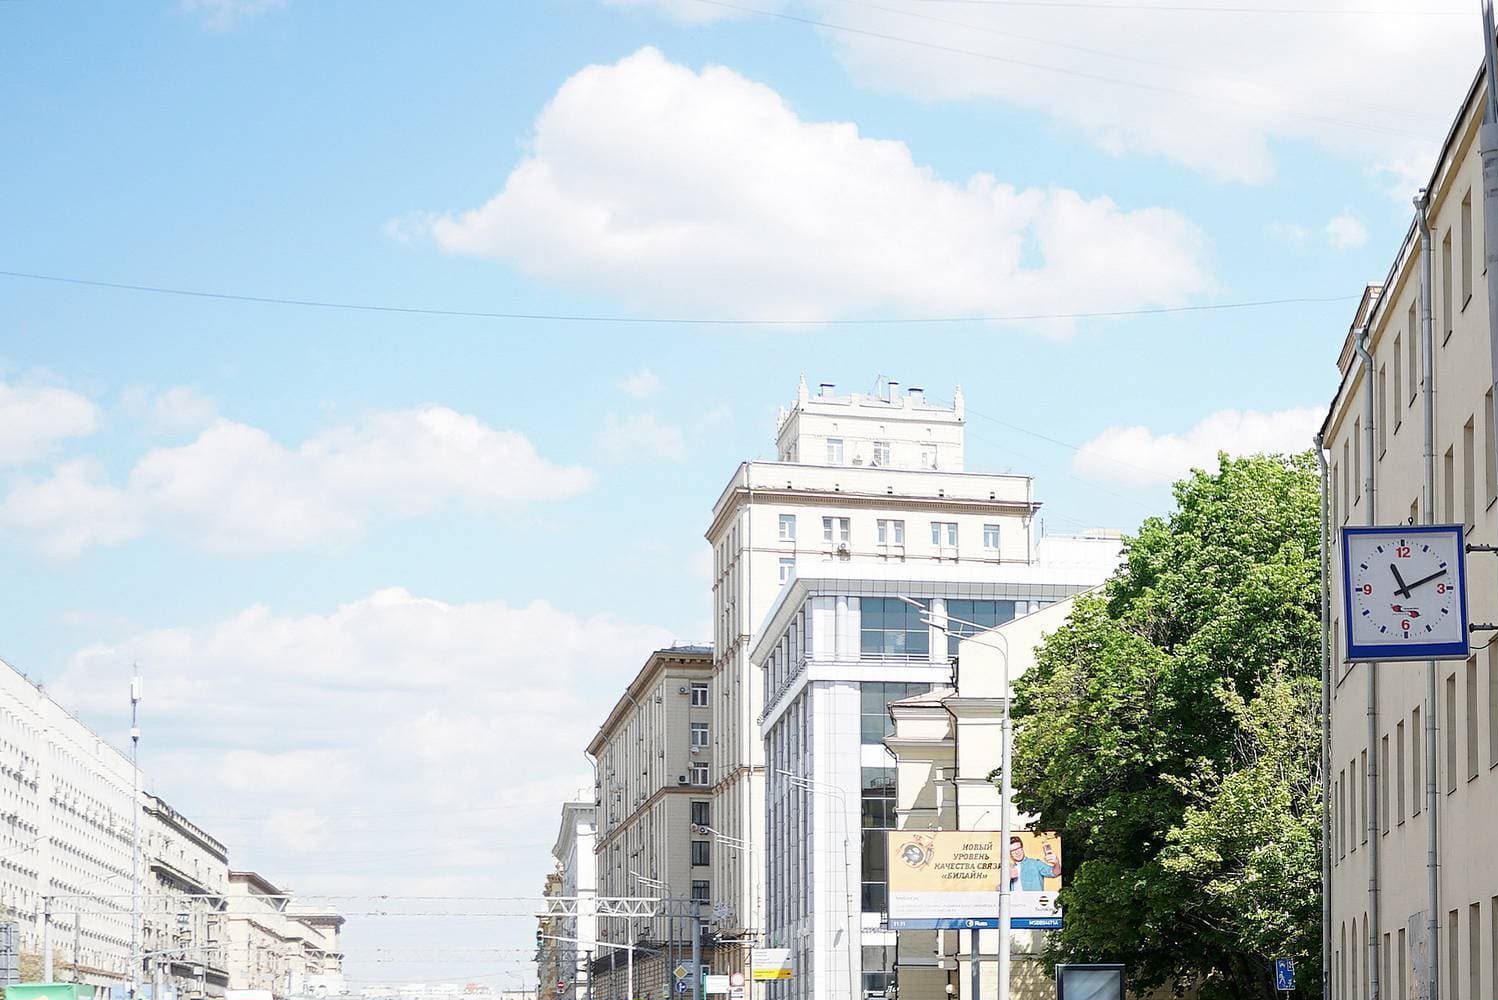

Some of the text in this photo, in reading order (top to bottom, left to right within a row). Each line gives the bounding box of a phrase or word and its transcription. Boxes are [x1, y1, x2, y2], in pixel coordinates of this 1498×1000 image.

[1395, 547, 1411, 558] 12
[1363, 584, 1372, 595] 9
[1437, 583, 1446, 594] 3
[1401, 619, 1410, 630] 6
[962, 841, 993, 851] НОВЫЙ
[952, 853, 990, 861] УРОВЕНЬ
[934, 862, 976, 870] КАЧЕСТВА
